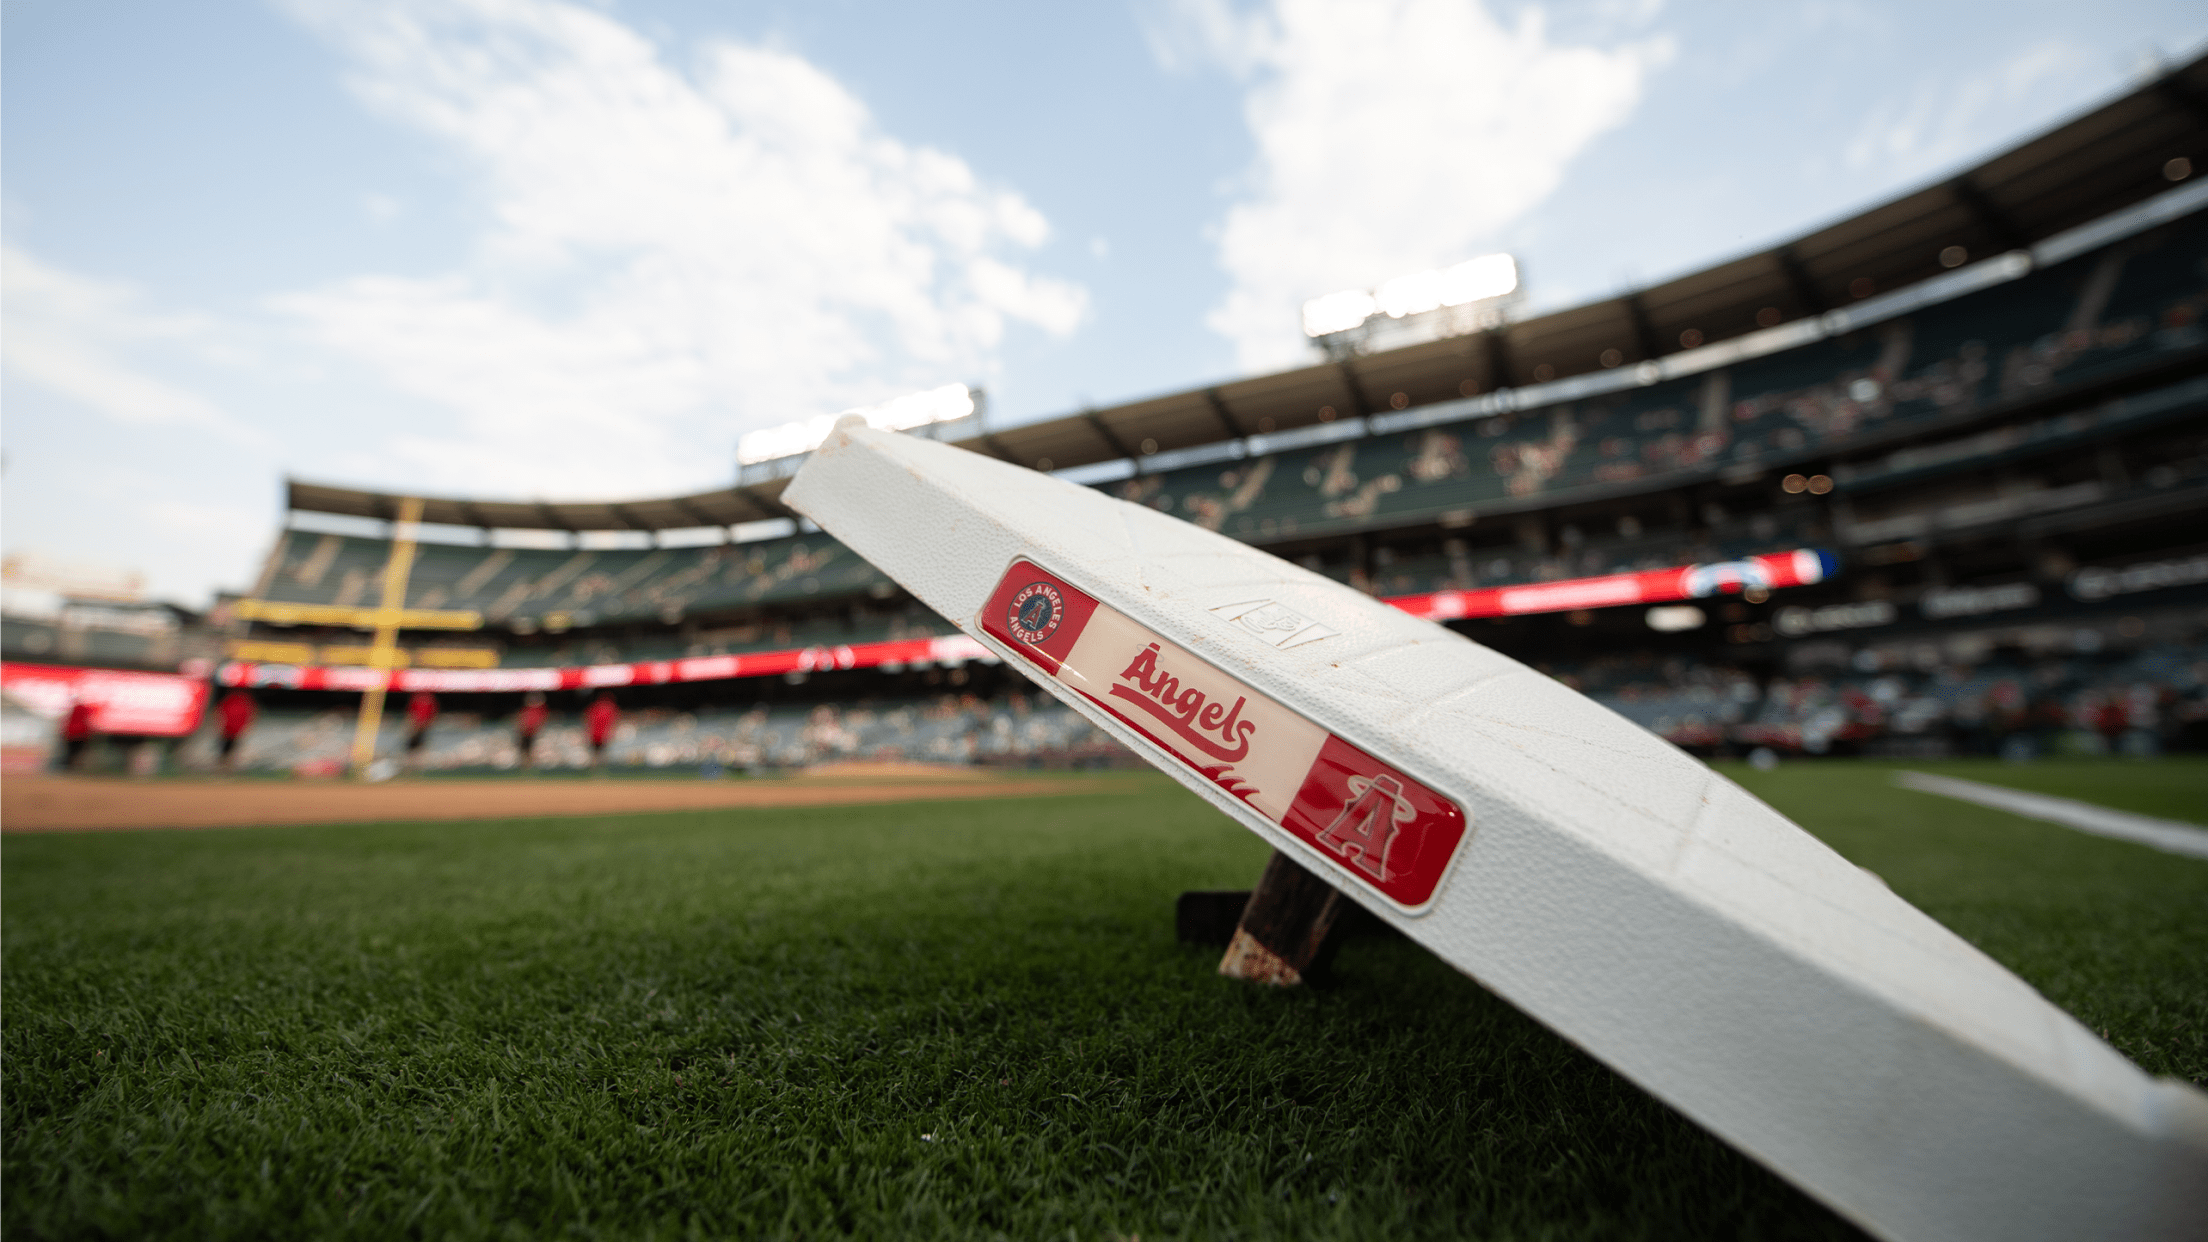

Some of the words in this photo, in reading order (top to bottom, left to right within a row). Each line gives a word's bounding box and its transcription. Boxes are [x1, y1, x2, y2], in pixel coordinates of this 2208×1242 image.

[1010, 616, 1044, 642] ANGELS
[1014, 588, 1033, 608] LOS
[1035, 585, 1062, 629] ANGELES
[1021, 597, 1047, 630] A
[1109, 642, 1256, 763] Angels
[1314, 774, 1418, 883] A
